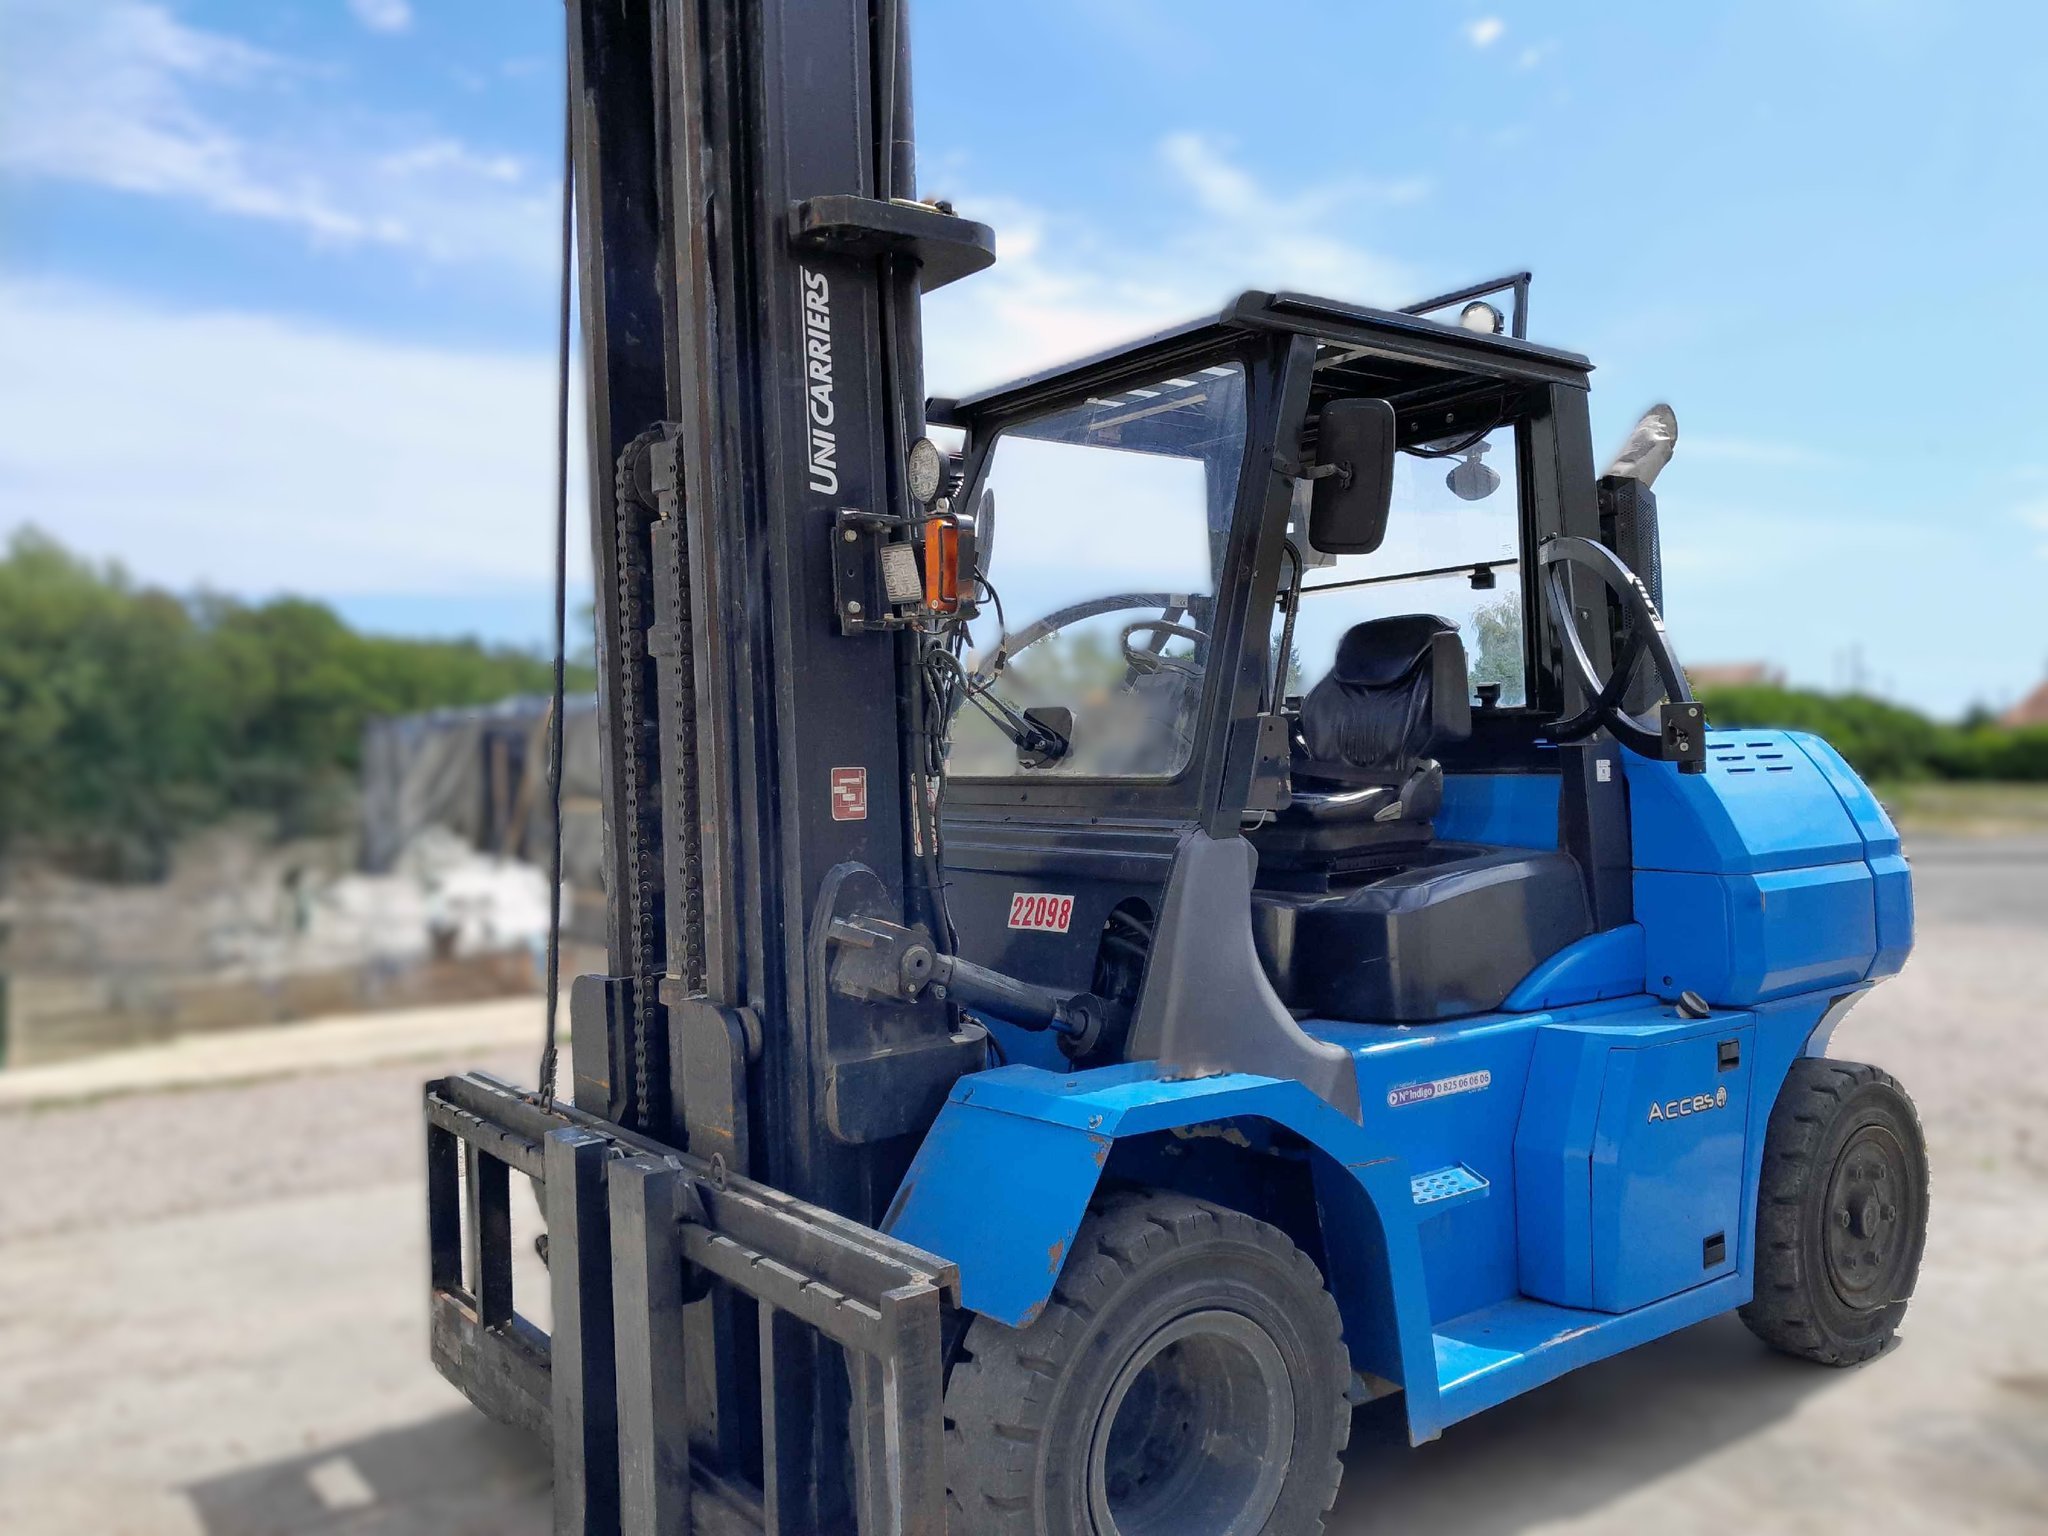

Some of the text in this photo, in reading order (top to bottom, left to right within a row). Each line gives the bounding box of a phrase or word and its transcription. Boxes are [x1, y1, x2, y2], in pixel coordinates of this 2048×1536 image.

[1010, 896, 1071, 929] 22098
[1436, 1084, 1442, 1093] 0
[1443, 1081, 1458, 1092] 825
[1458, 1078, 1468, 1088] 06
[1469, 1075, 1479, 1086] 06
